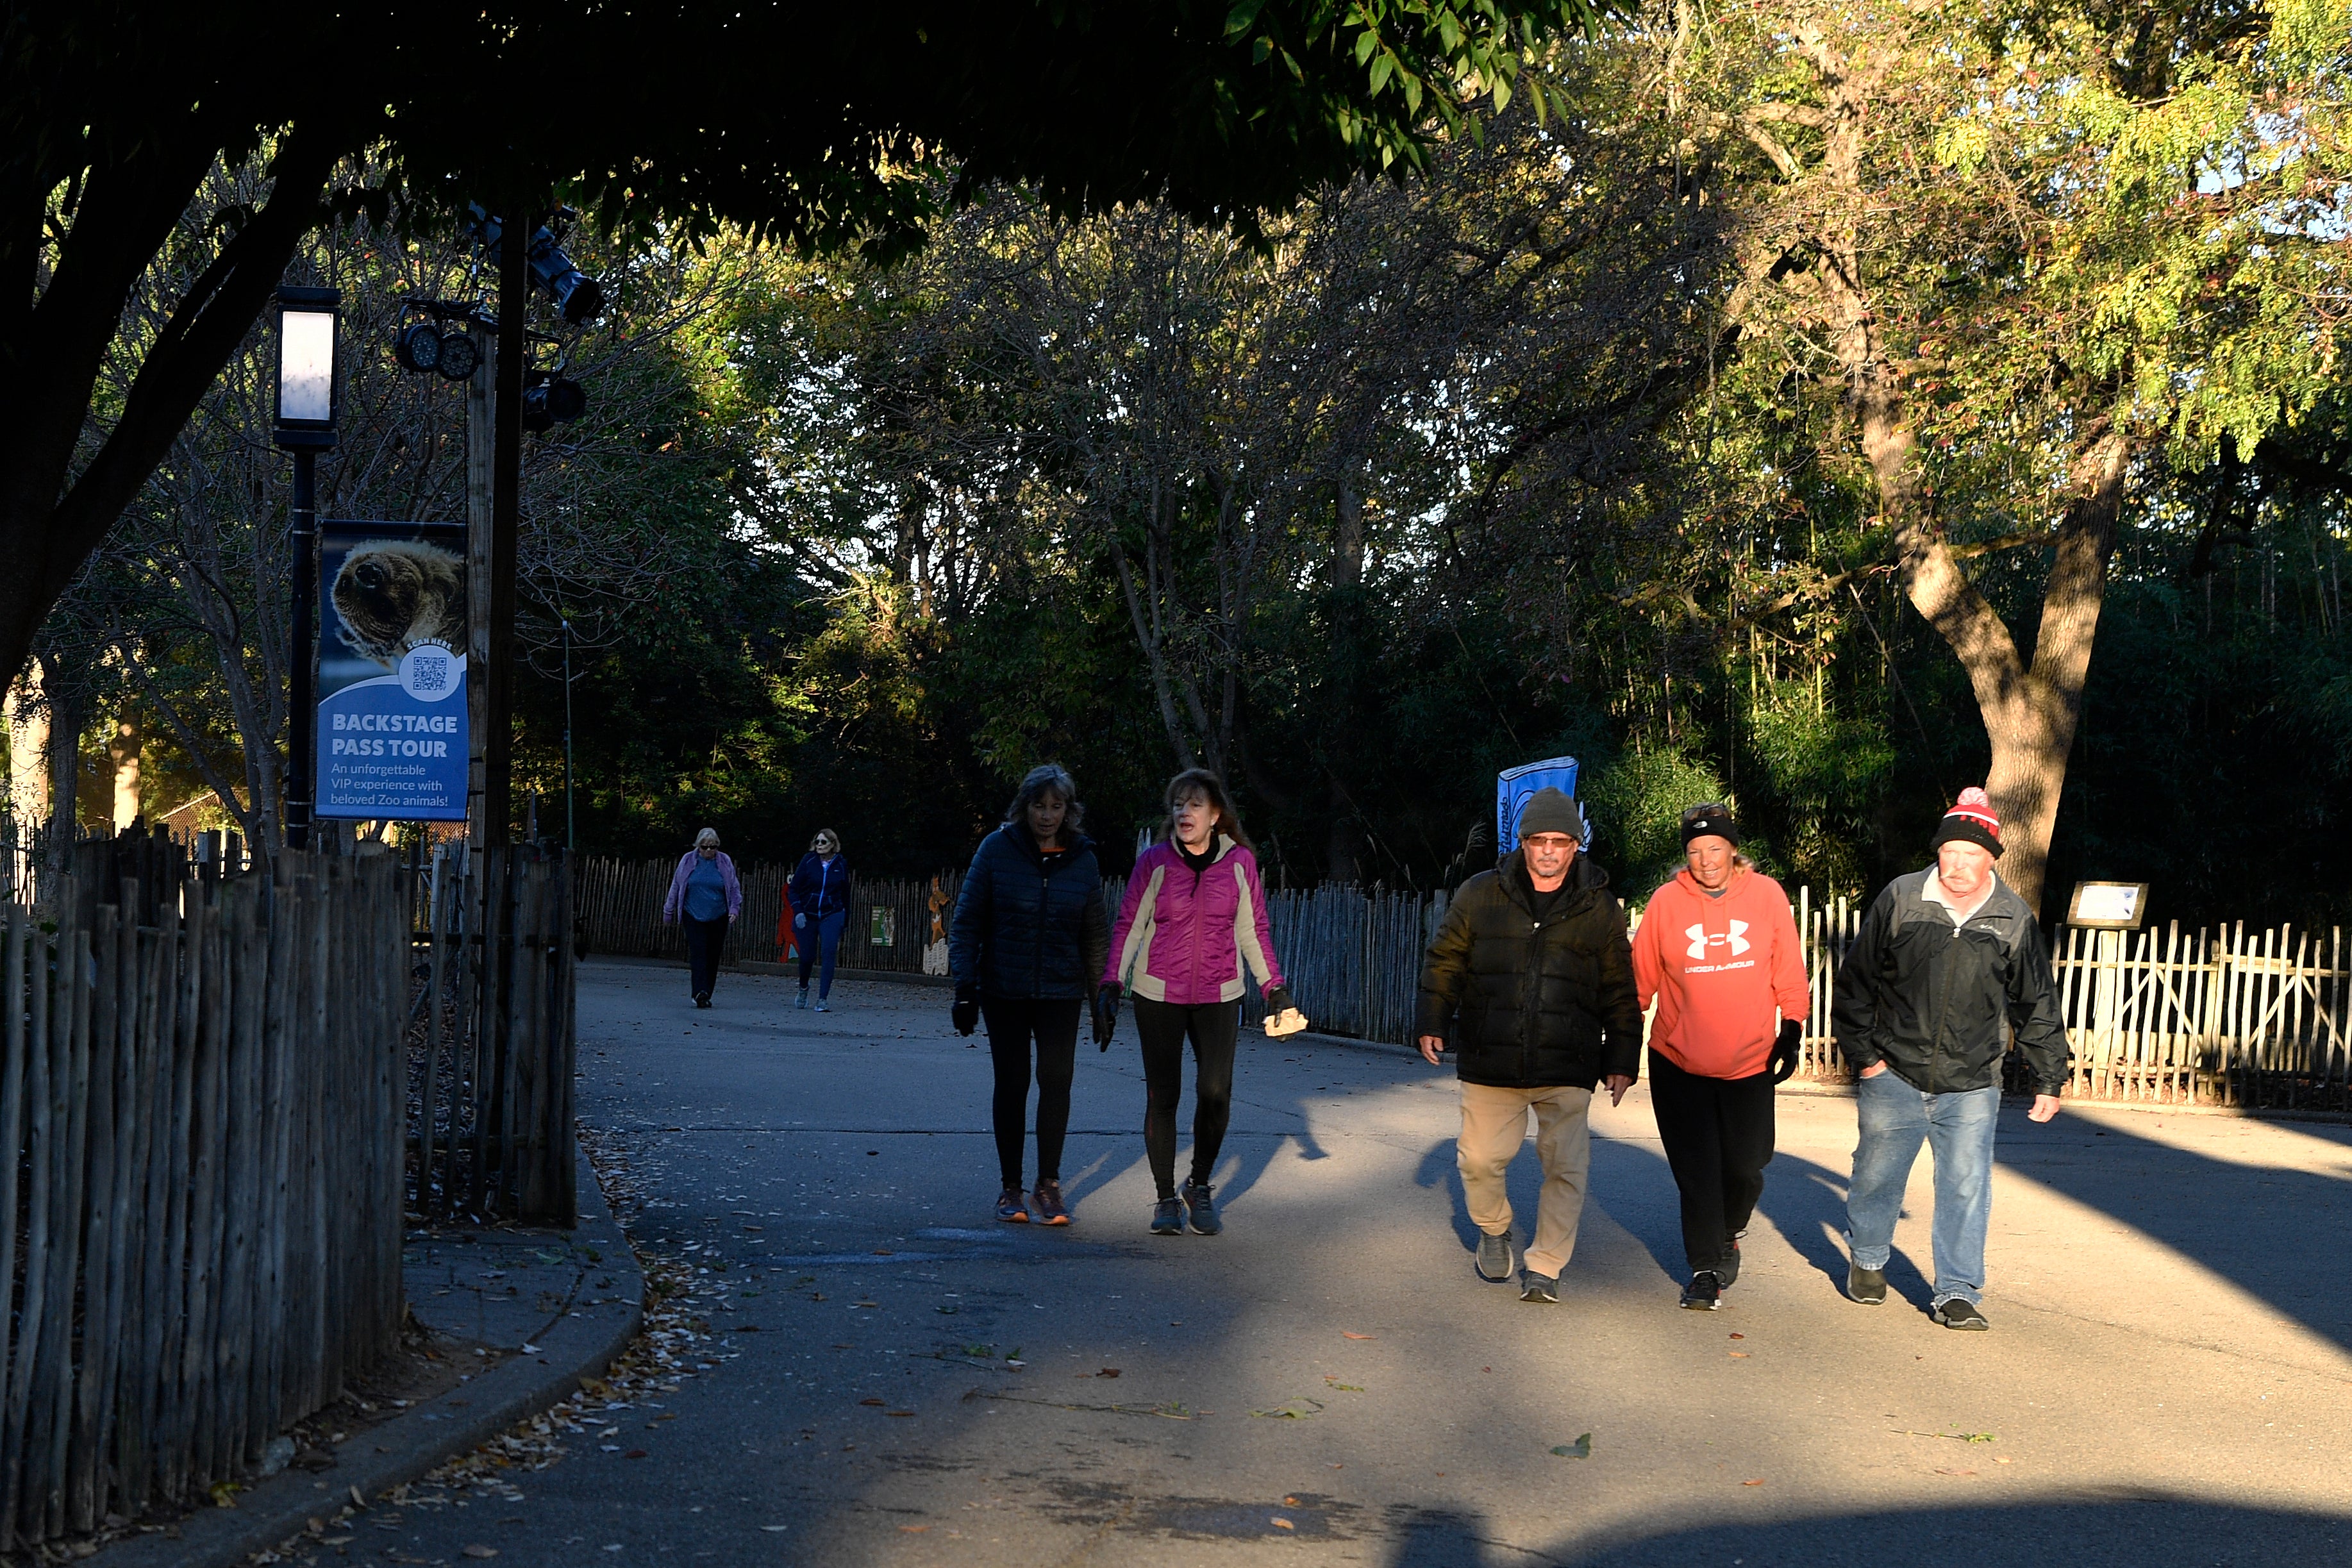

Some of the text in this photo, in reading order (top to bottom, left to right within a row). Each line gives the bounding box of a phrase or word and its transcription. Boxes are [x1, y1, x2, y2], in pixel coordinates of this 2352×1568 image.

[406, 637, 453, 651] SCAN HERE
[333, 713, 458, 733] BACKSTAGE
[331, 738, 447, 758] PASS TOUR
[331, 763, 426, 776] An unforgettable
[331, 778, 443, 792] VIP experience with
[331, 793, 449, 807] beloved Zoo animals!
